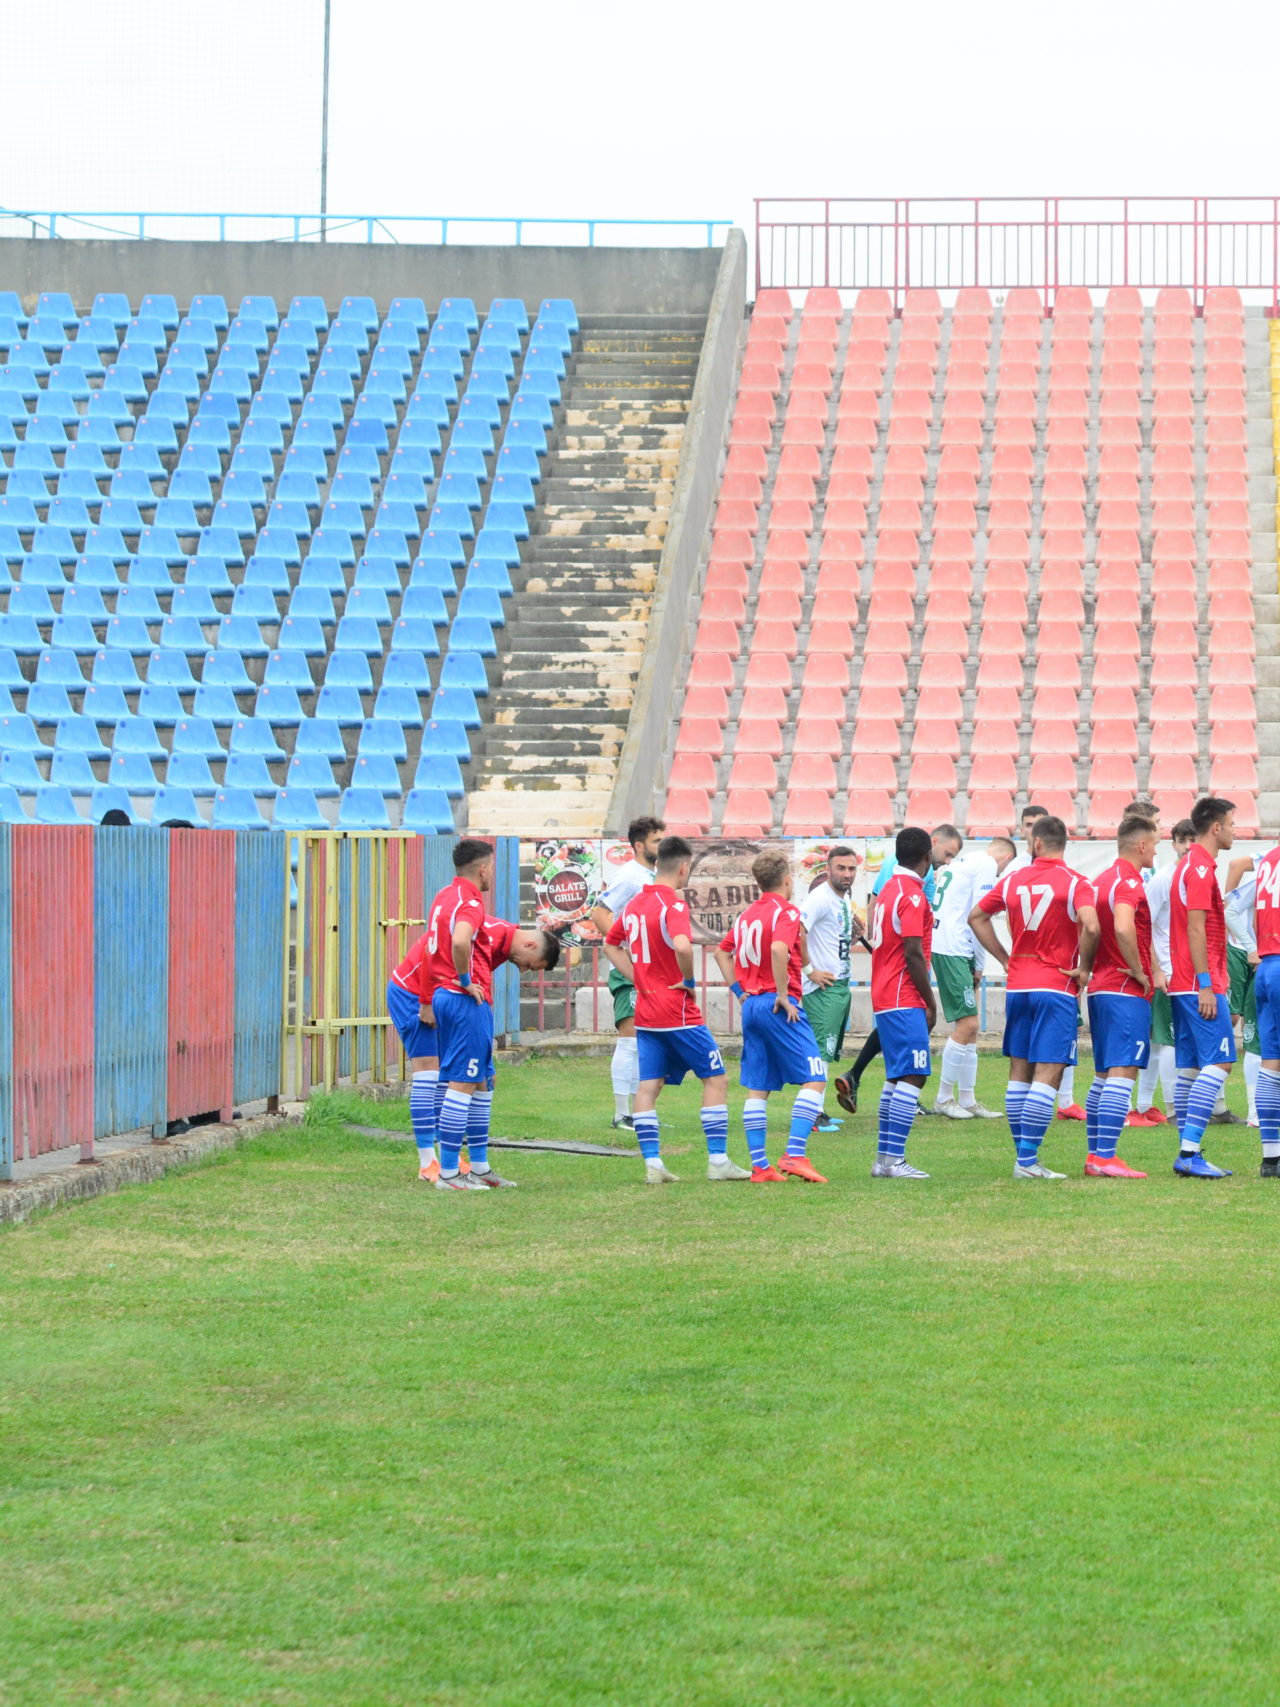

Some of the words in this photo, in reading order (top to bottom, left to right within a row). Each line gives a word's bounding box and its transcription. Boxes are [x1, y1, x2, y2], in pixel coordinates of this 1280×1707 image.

[548, 881, 586, 893] SALATE
[931, 870, 953, 912] 3
[554, 892, 583, 903] GRILL
[1016, 884, 1055, 931] 17
[428, 905, 442, 955] 5
[625, 913, 652, 964] 21
[739, 918, 763, 969] 10
[1135, 1040, 1145, 1060] 7
[1219, 1037, 1230, 1057] 4
[466, 1058, 479, 1078] 5
[709, 1049, 724, 1070] 21
[807, 1056, 824, 1076] 10
[911, 1049, 927, 1069] 18
